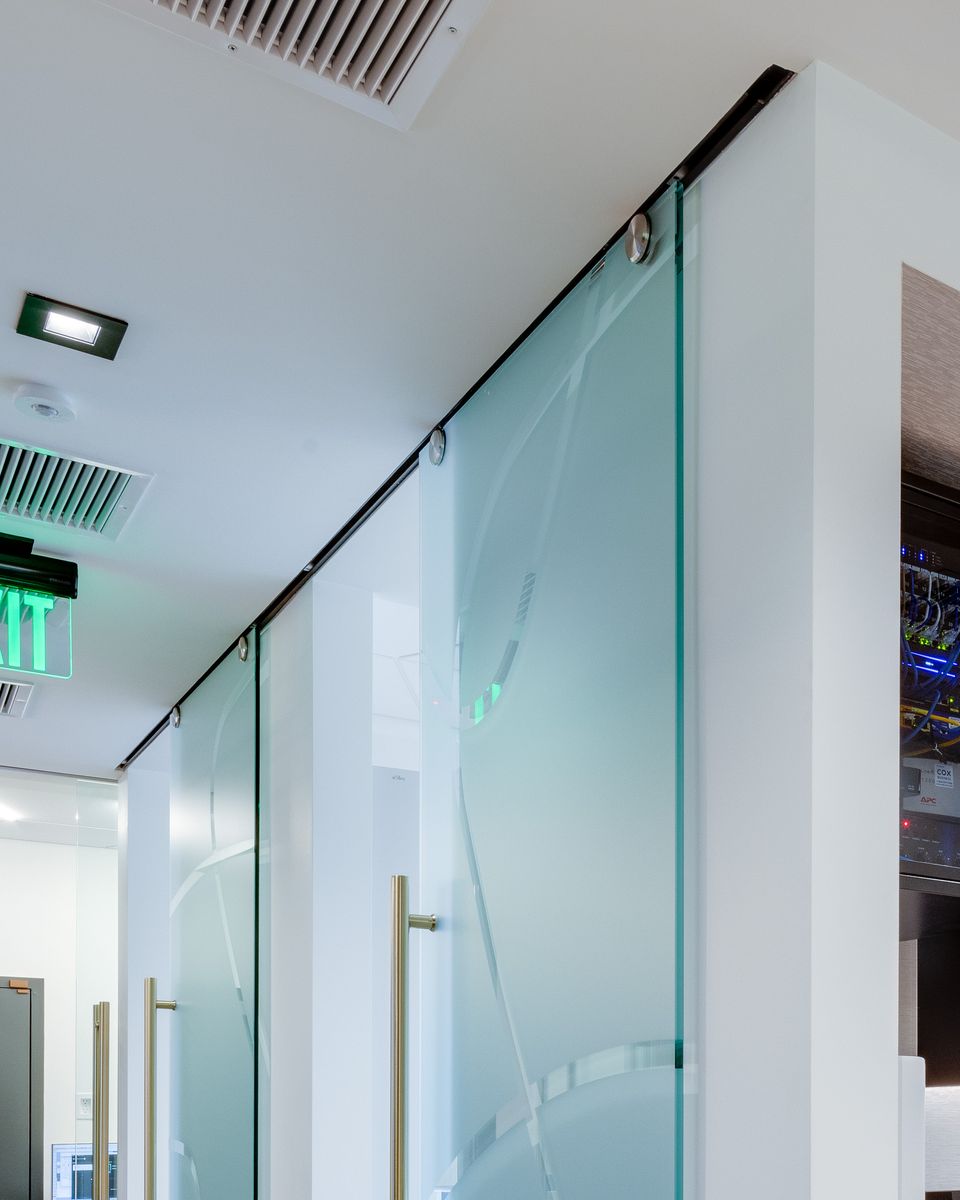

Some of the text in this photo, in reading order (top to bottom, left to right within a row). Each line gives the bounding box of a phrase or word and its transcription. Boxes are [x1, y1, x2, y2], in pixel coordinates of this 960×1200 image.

[0, 589, 54, 671] IT
[936, 768, 952, 777] COX
[920, 796, 937, 804] APC
